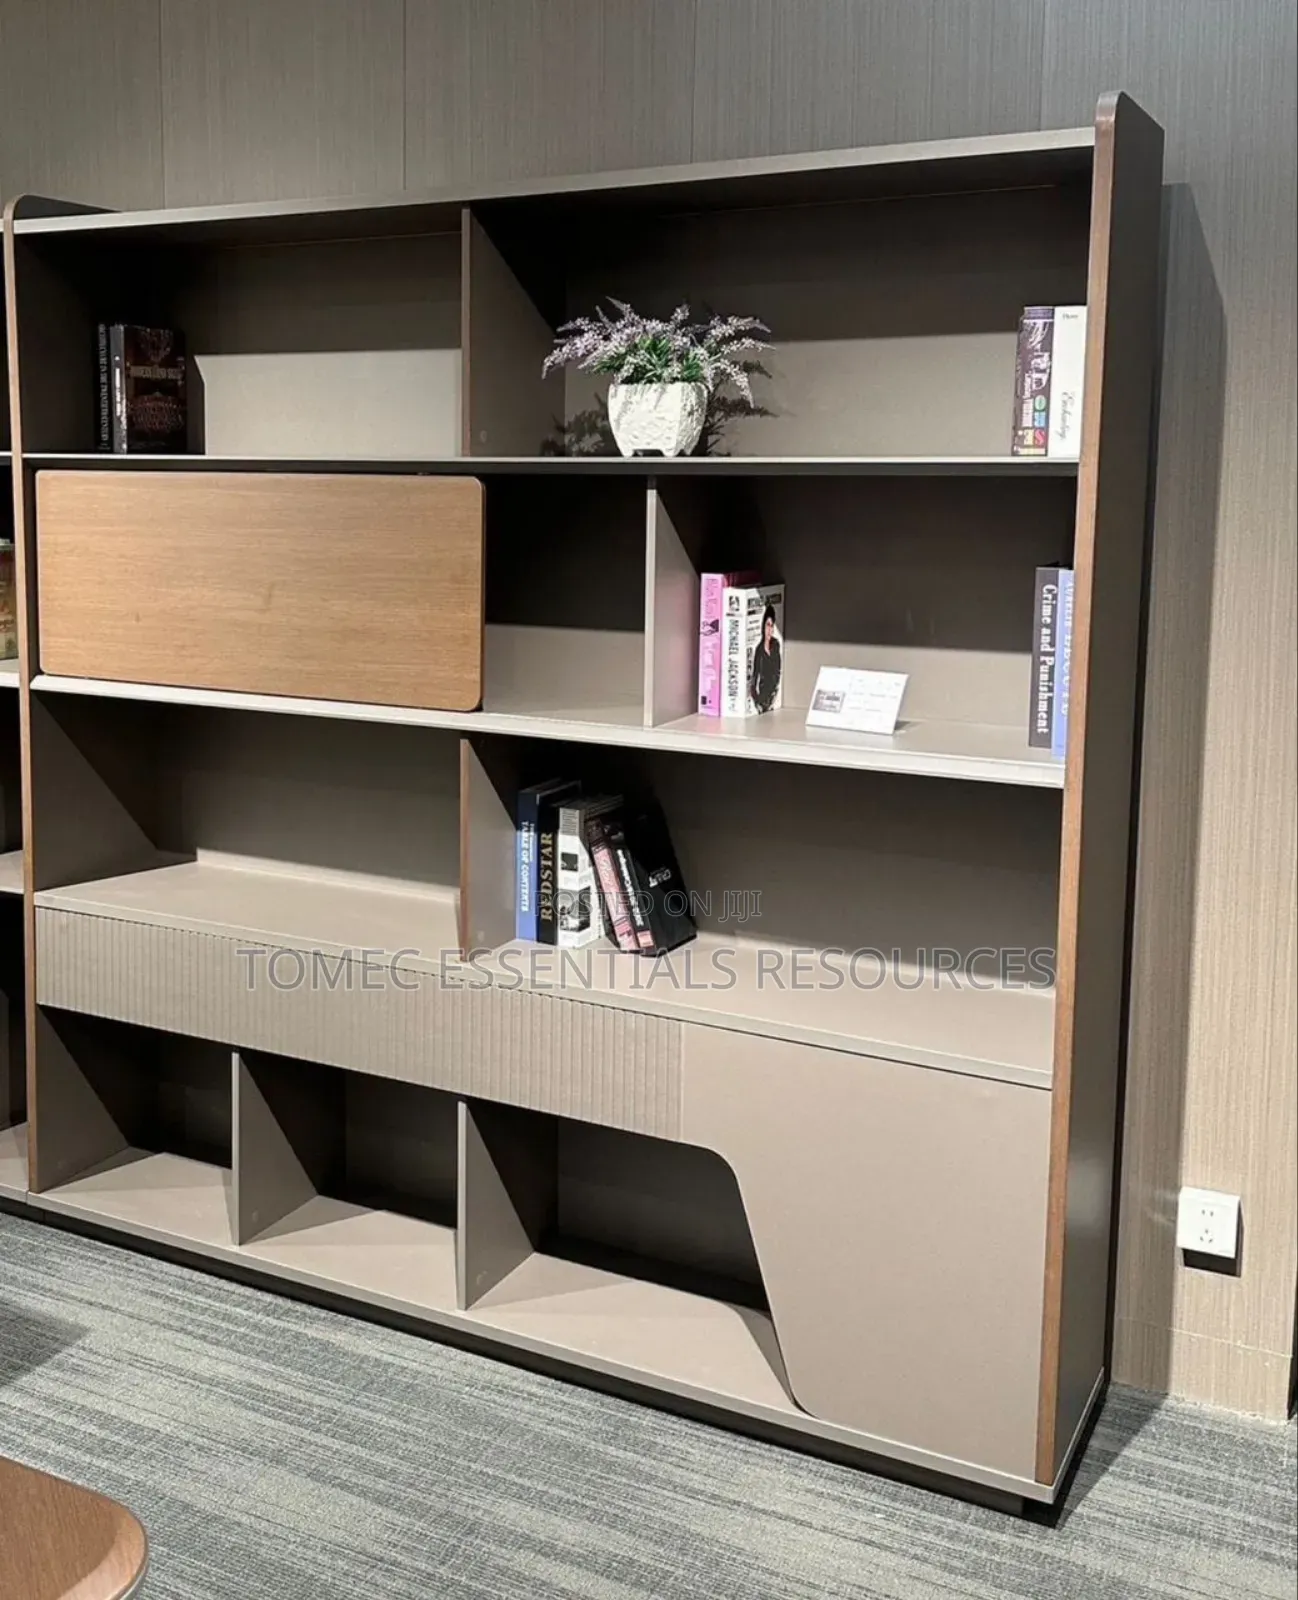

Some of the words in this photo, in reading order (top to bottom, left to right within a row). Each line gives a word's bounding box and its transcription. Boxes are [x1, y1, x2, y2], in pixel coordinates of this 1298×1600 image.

[1041, 584, 1058, 625] Crime
[728, 619, 740, 656] MICHAEL
[1040, 627, 1055, 652] and
[727, 658, 739, 697] JACKSON
[1036, 655, 1055, 734] Punishment
[520, 821, 530, 848] TABLE
[520, 849, 530, 863] OF
[520, 864, 530, 912] CONTENTS
